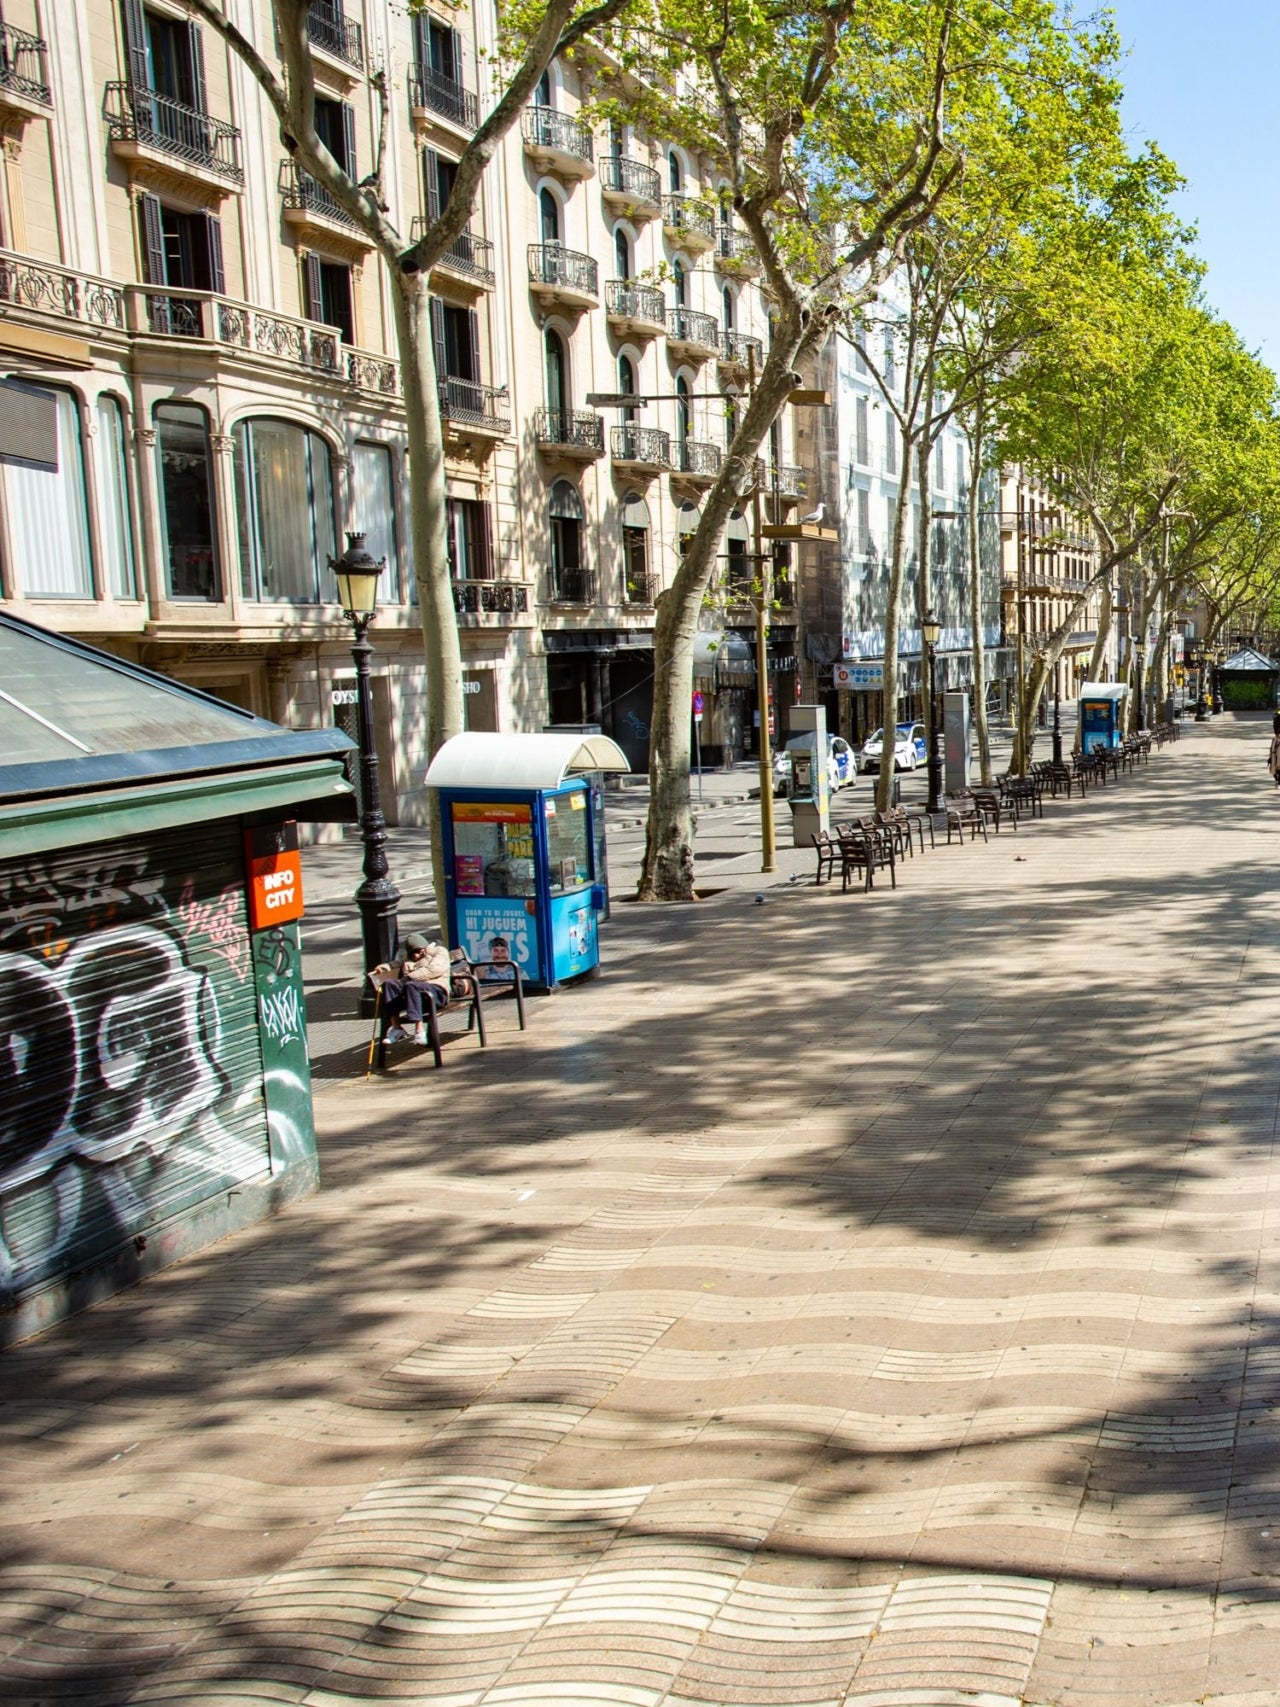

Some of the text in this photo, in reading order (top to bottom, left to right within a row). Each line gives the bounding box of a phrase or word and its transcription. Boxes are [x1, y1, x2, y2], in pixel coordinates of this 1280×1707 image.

[264, 870, 294, 890] INFO
[265, 888, 295, 909] CITY
[466, 917, 527, 931] HI JUGUEM
